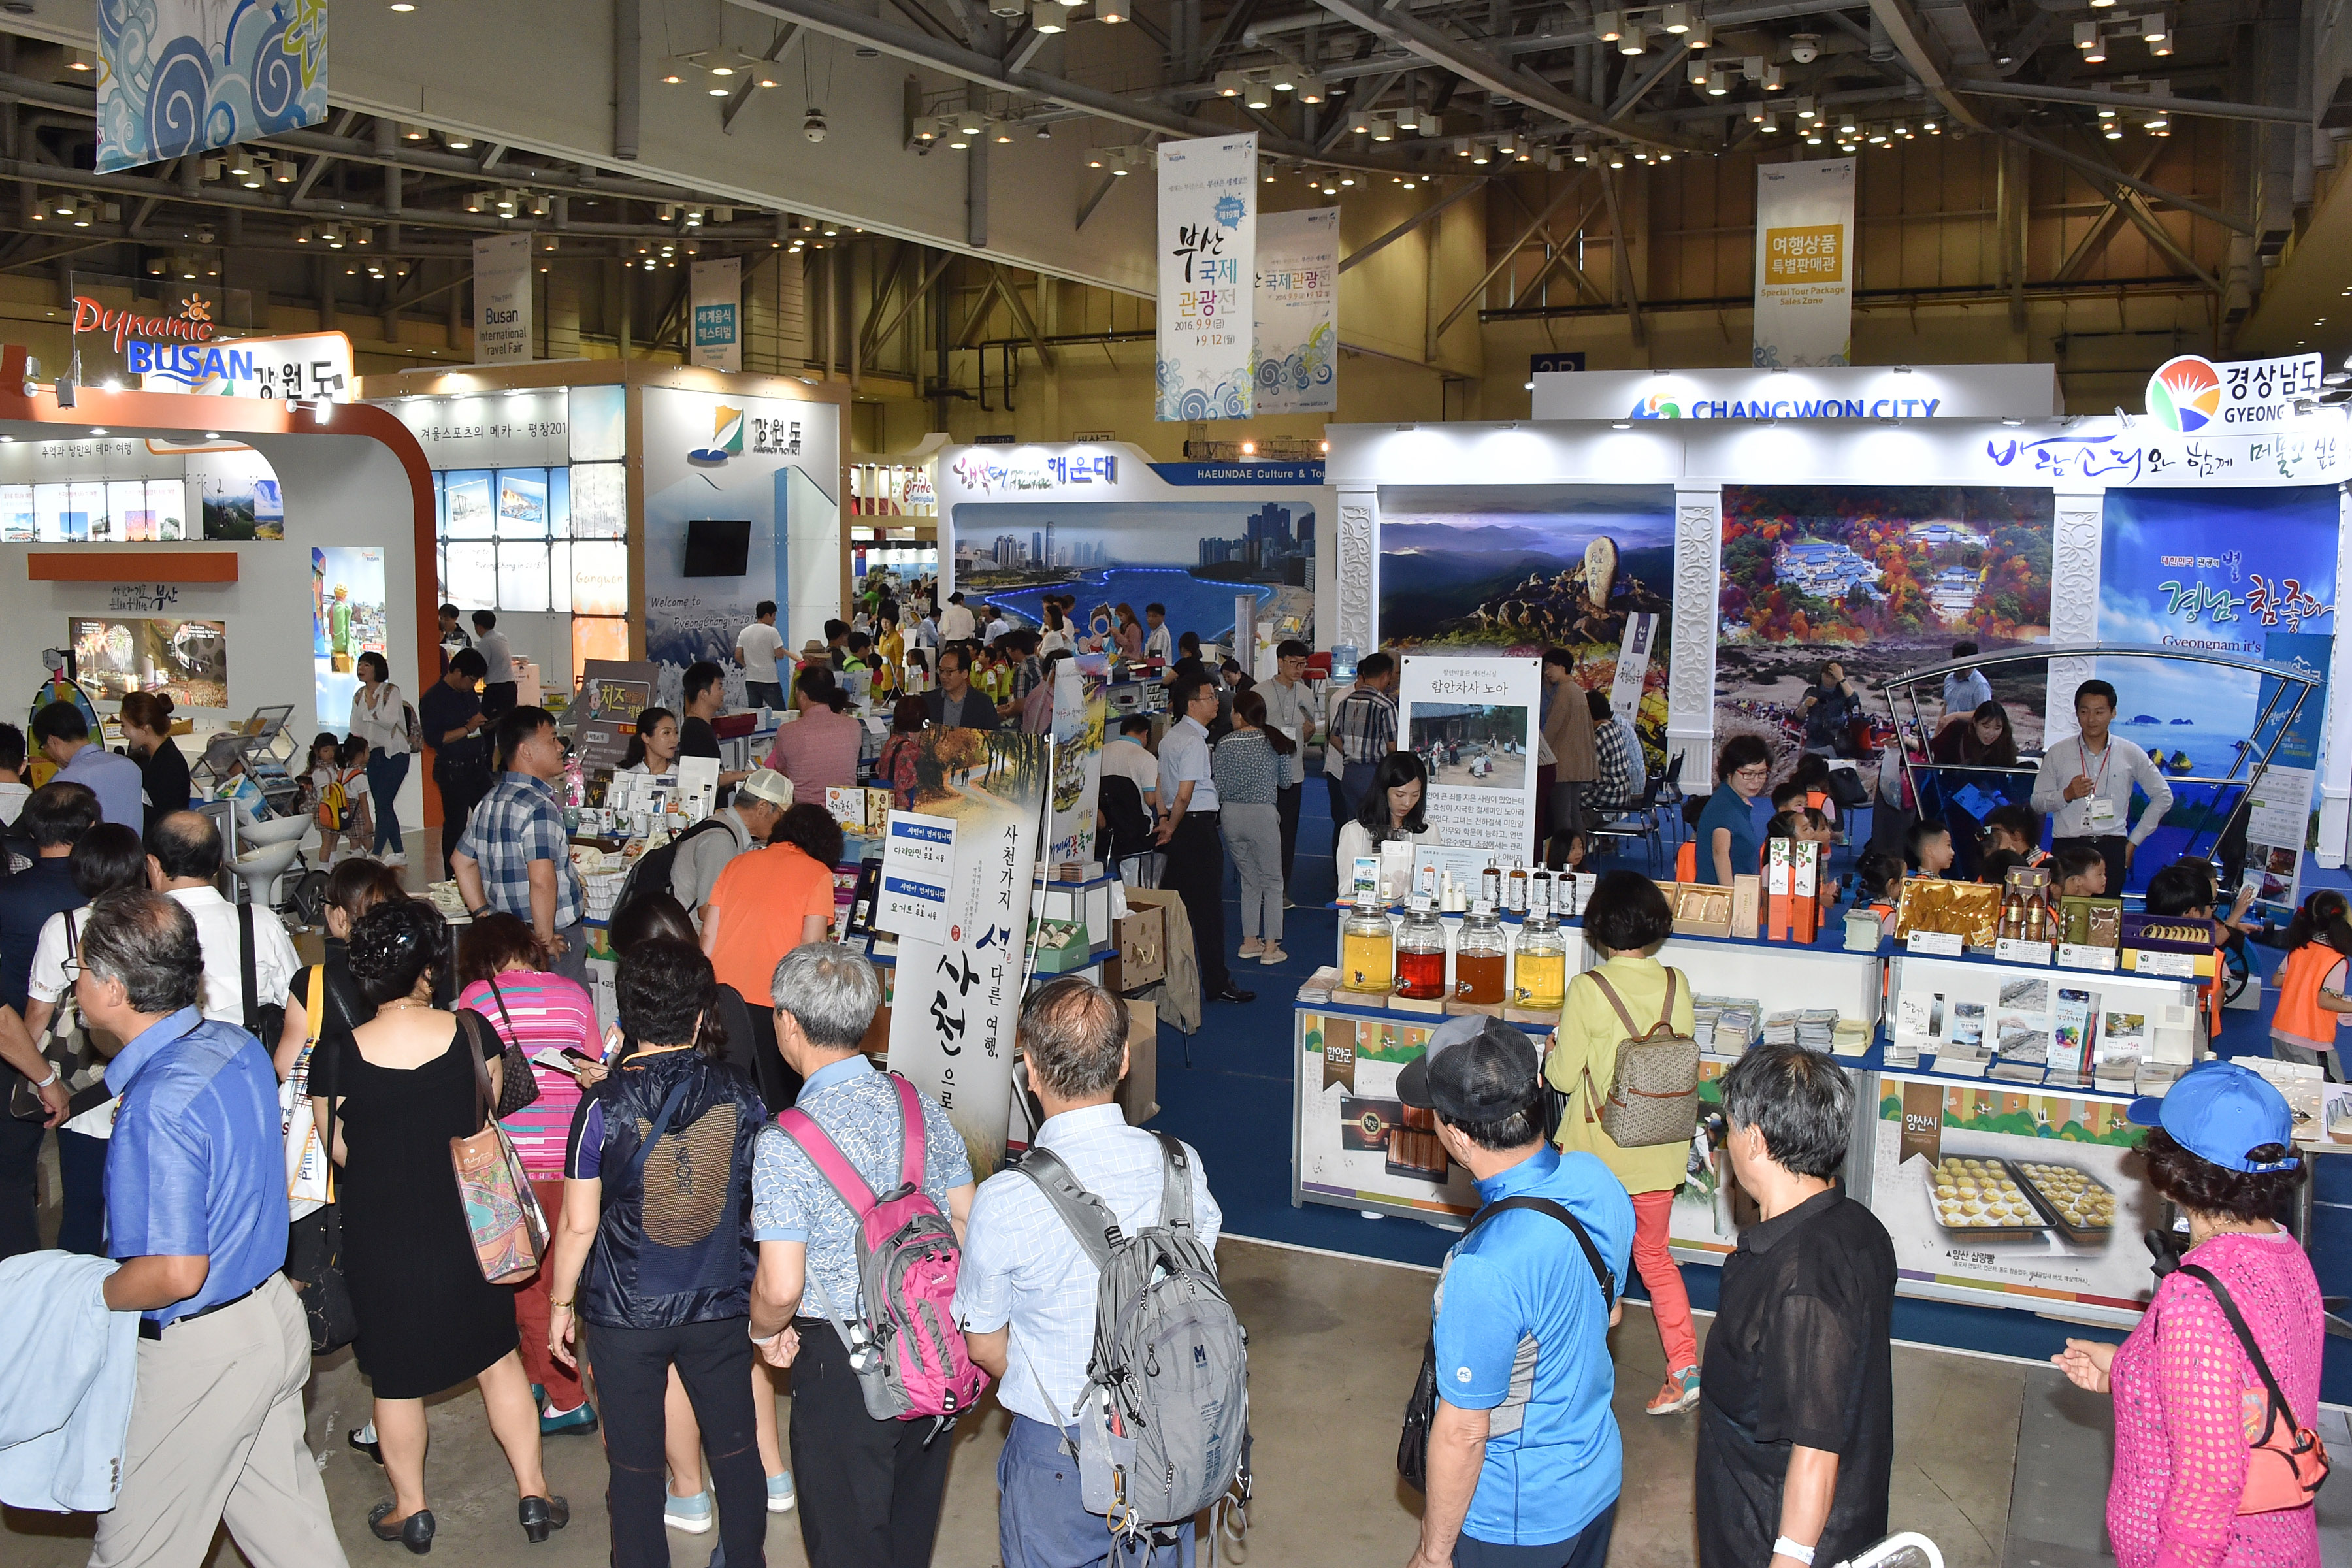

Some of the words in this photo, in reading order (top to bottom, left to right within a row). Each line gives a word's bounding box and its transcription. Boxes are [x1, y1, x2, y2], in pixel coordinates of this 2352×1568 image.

[1218, 210, 1240, 220] 제19회
[1173, 222, 1224, 283] 부산
[1772, 235, 1837, 255] 여행상품
[1198, 258, 1237, 287] 국제
[1772, 257, 1836, 274] 특별판매관
[1265, 270, 1331, 291] 국제관광전
[1761, 288, 1789, 297] Special
[1810, 286, 1846, 296] Package
[1178, 289, 1236, 318] 관광전
[486, 308, 519, 325] Busan
[698, 309, 732, 322] 세계음식
[73, 296, 214, 353] Dynamic
[698, 325, 732, 340] 페스티벌
[1174, 321, 1195, 331] 2016.
[1213, 318, 1225, 329] (금)
[479, 327, 527, 342] International
[1223, 335, 1235, 346] (월)
[484, 343, 506, 356] Travel
[508, 342, 523, 355] Fair
[128, 340, 253, 380] BUSAN
[255, 361, 334, 399] 강원도
[2227, 361, 2315, 400] 경상남도
[1692, 400, 1863, 418] CHANGWON
[1872, 399, 1940, 417] CITY
[421, 425, 483, 442] 겨울스포츠의
[489, 423, 512, 438] 메카
[755, 418, 801, 444] 강원도
[42, 446, 65, 459] 추억과
[69, 444, 91, 457] 낭만의
[96, 443, 112, 455] 테마
[116, 442, 132, 455] 여행
[2186, 442, 2233, 478] 함께
[1048, 456, 1115, 483] 해운대
[1198, 470, 1252, 478] HAEUNDAE
[1257, 469, 1293, 478] Culture
[1299, 469, 1305, 478] &
[910, 495, 934, 504] GyeongBuk
[2161, 556, 2194, 568] 대한민국
[2197, 557, 2219, 568] 관광의
[2222, 550, 2242, 583] 별
[576, 572, 623, 588] Gangwon
[651, 597, 688, 608] Welcome
[692, 595, 701, 606] to
[673, 615, 728, 632] PyeongChang
[730, 616, 738, 625] in
[2243, 639, 2261, 653] it's
[1431, 680, 1479, 695] 함안차사
[1483, 682, 1509, 696] 노아
[601, 684, 625, 711] 치즈
[625, 691, 645, 704] 만들기
[1449, 792, 1462, 802] 죄를
[1463, 794, 1476, 802] 지은
[1478, 794, 1497, 804] 사람이
[1499, 795, 1525, 806] 있었는데
[1433, 804, 1452, 813] 효성이
[1455, 806, 1475, 815] 지극한
[1477, 806, 1502, 815] 절세미인
[1505, 808, 1524, 817] 노아라
[1453, 816, 1472, 825] 그녀는
[1475, 817, 1501, 826] 천하절색
[1504, 819, 1524, 828] 미인일
[907, 827, 925, 837] 시민이
[926, 830, 952, 841] 먼저입니다
[1442, 826, 1461, 836] 가무와
[1463, 827, 1482, 837] 학문에
[1510, 830, 1523, 840] 언변
[1510, 841, 1523, 851] 관리
[923, 852, 932, 860] 무료
[998, 824, 1019, 911] 사천가지
[900, 883, 917, 893] 시민이
[919, 887, 945, 900] 먼저입니다
[890, 903, 913, 915] 요거트
[988, 964, 1004, 1007] 다른
[983, 1015, 1000, 1060] 여행,
[1326, 1045, 1352, 1063] 함안군
[1906, 1113, 1938, 1132] 양산시
[1953, 1249, 1969, 1261] 양산
[1971, 1252, 1995, 1264] 삽량빵
